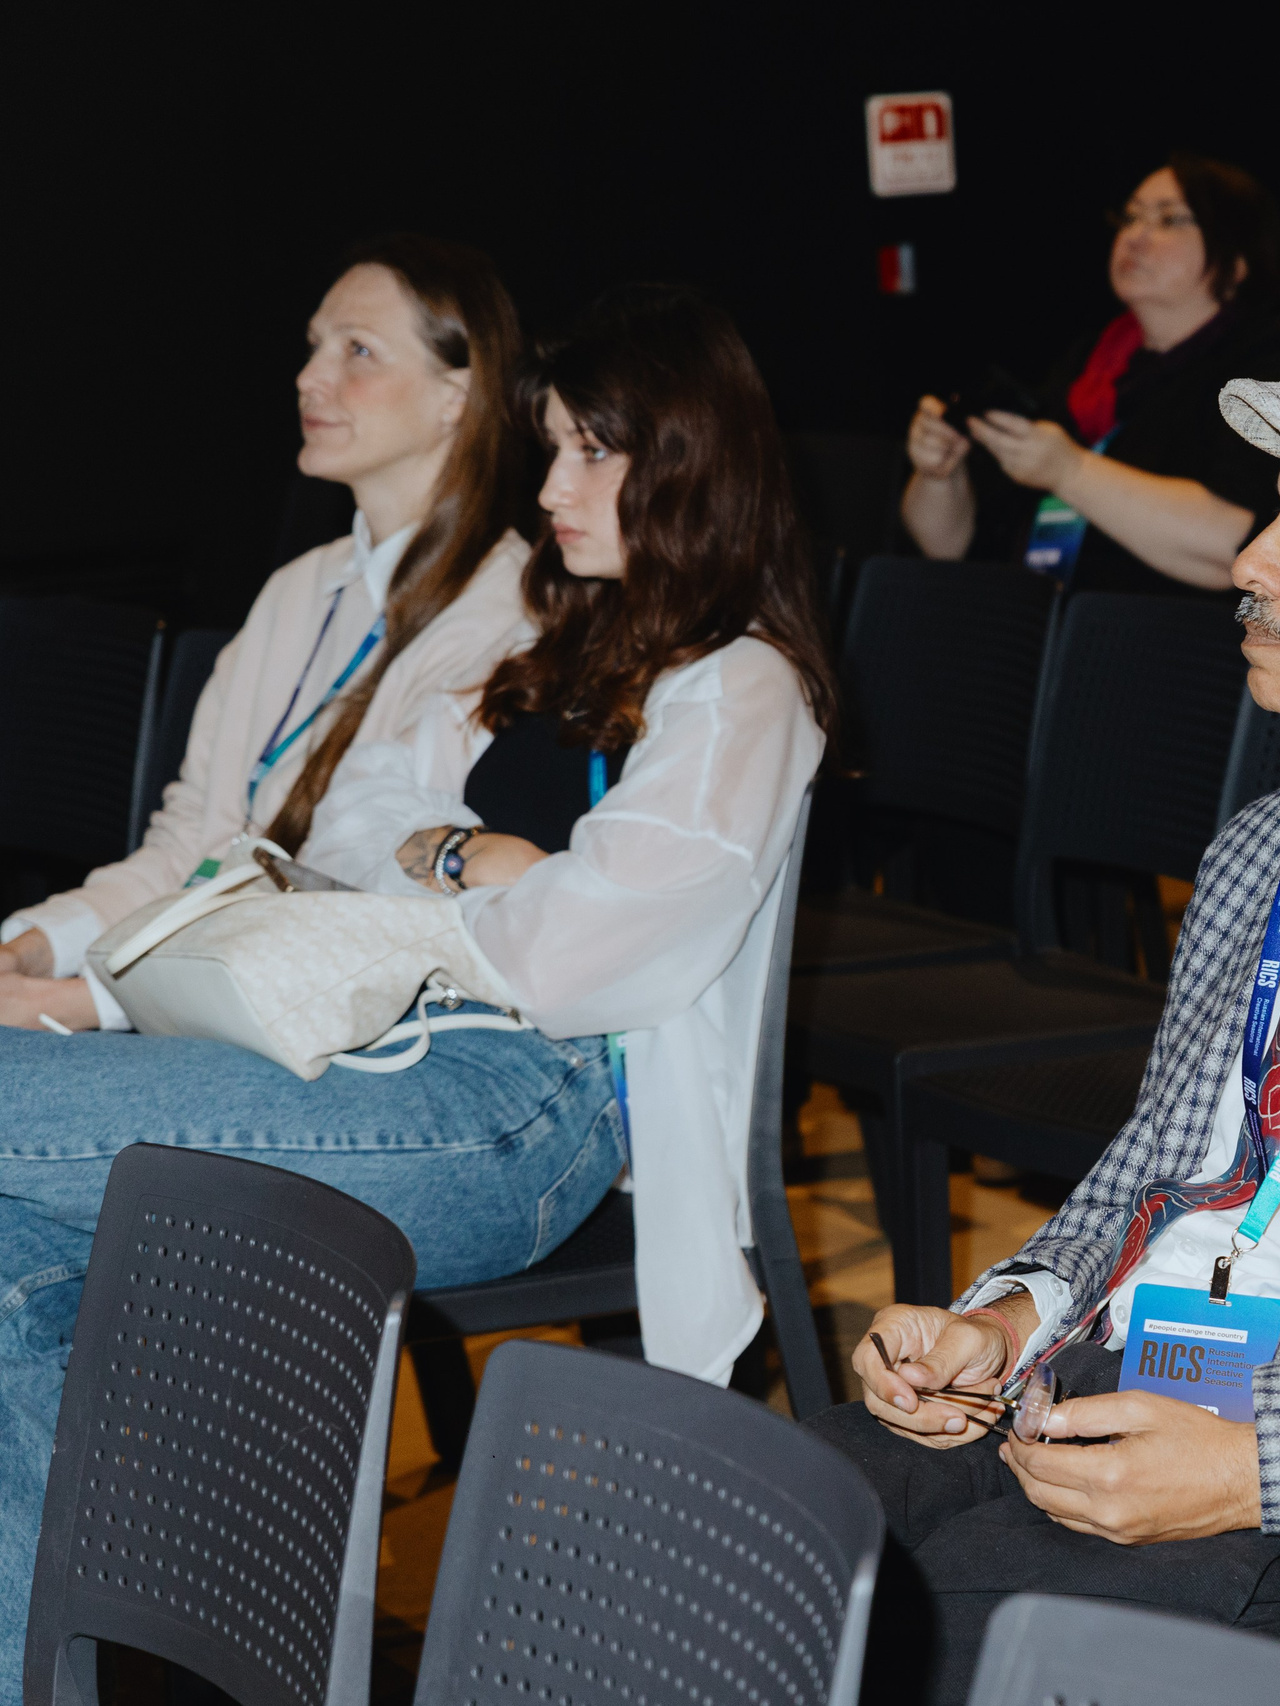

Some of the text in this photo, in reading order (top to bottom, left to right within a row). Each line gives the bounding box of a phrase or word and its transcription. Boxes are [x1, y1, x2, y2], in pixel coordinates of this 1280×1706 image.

[1258, 960, 1280, 989] RICS
[1253, 997, 1263, 1020] Creative
[1253, 999, 1270, 1056] Russian International
[1244, 1076, 1256, 1105] RICS
[1149, 1324, 1176, 1332] #people
[1178, 1327, 1203, 1335] change
[1217, 1332, 1244, 1340] country
[1138, 1340, 1205, 1382] RICS
[1209, 1348, 1245, 1358] Russian
[1206, 1368, 1244, 1378] Creative
[1207, 1358, 1256, 1369] Internation
[1205, 1377, 1243, 1388] Seasons
